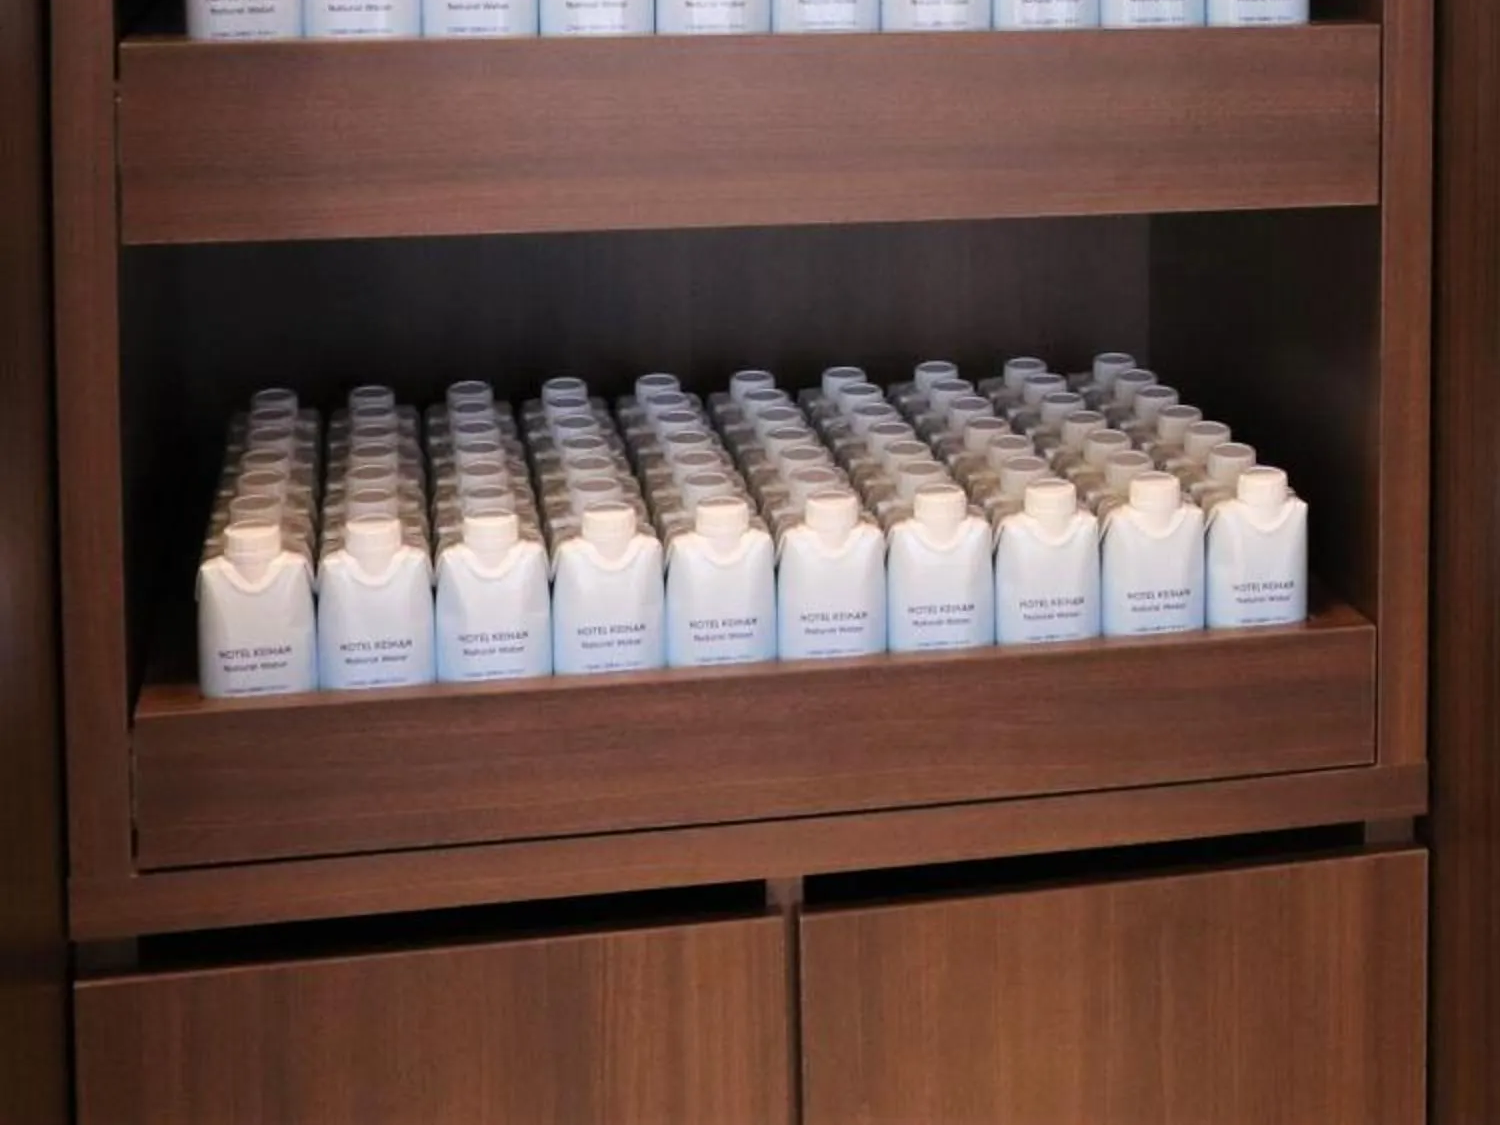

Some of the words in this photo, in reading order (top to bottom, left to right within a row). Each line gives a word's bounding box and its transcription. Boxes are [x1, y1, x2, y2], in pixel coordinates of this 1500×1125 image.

[1233, 583, 1261, 592] HOTEL
[1127, 591, 1157, 600] HOTEL
[1019, 599, 1050, 608] HOTEL
[908, 606, 939, 615] HOTEL
[800, 613, 831, 622] HOTEL
[689, 619, 721, 629] HOTEL
[577, 625, 609, 636] HOTEL
[458, 632, 490, 643] HOTEL
[340, 641, 373, 652] HOTEL
[219, 648, 252, 659] HOTEL
